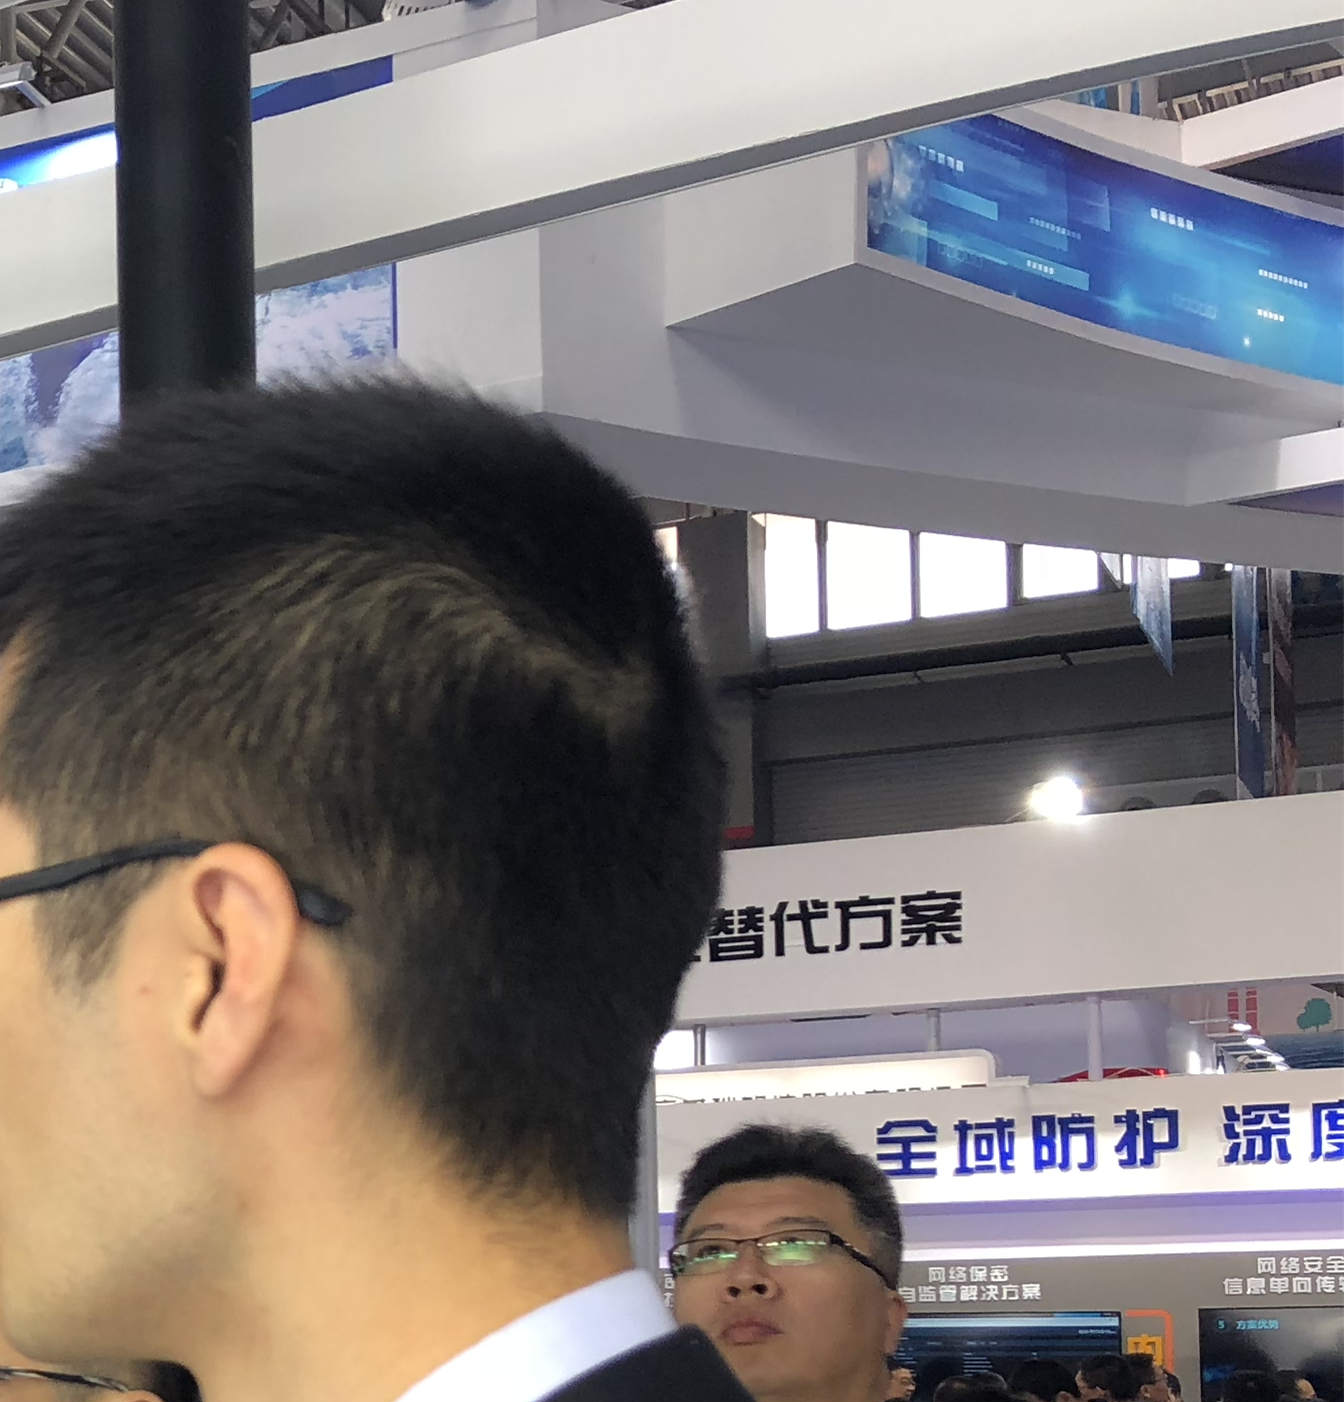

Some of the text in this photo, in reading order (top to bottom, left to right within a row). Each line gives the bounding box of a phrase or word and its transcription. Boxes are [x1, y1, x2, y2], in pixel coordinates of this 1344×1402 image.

[707, 890, 963, 962] 替代方案
[875, 1107, 1179, 1178] 全域防护
[928, 1265, 1009, 1283] 网络保密
[1257, 1255, 1344, 1275] 网络安全
